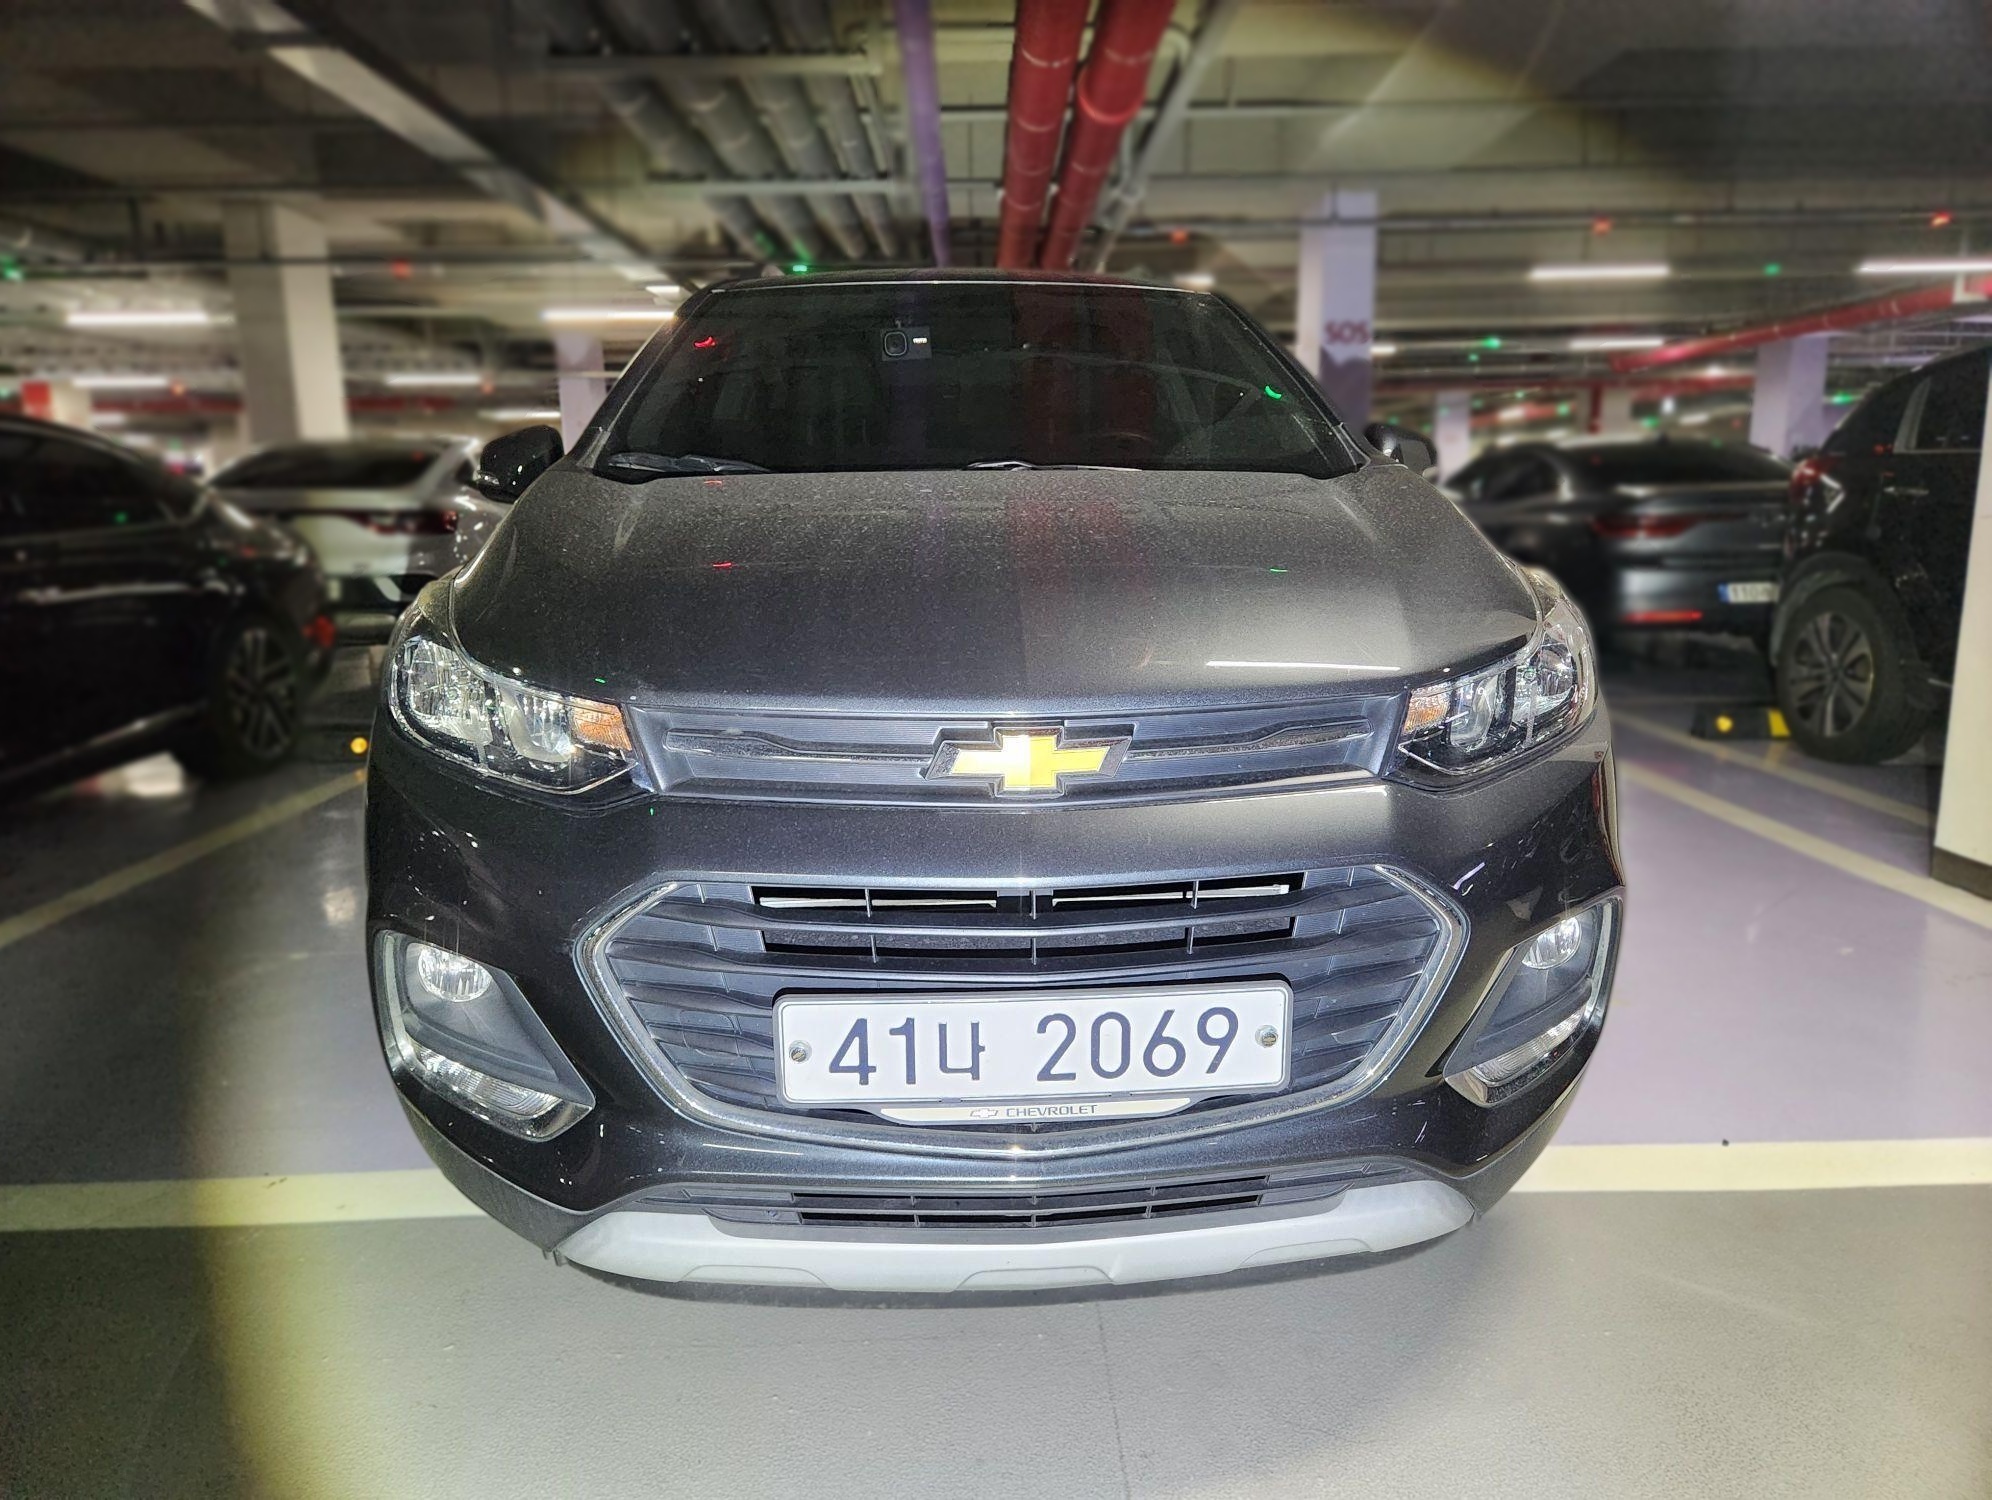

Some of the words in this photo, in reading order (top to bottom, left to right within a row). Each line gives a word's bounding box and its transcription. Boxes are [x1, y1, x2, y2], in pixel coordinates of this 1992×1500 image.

[1325, 320, 1371, 345] SOS
[828, 1017, 986, 1086] 41나
[1036, 1006, 1239, 1082] 2069
[1006, 1104, 1098, 1117] CHEVROLET
